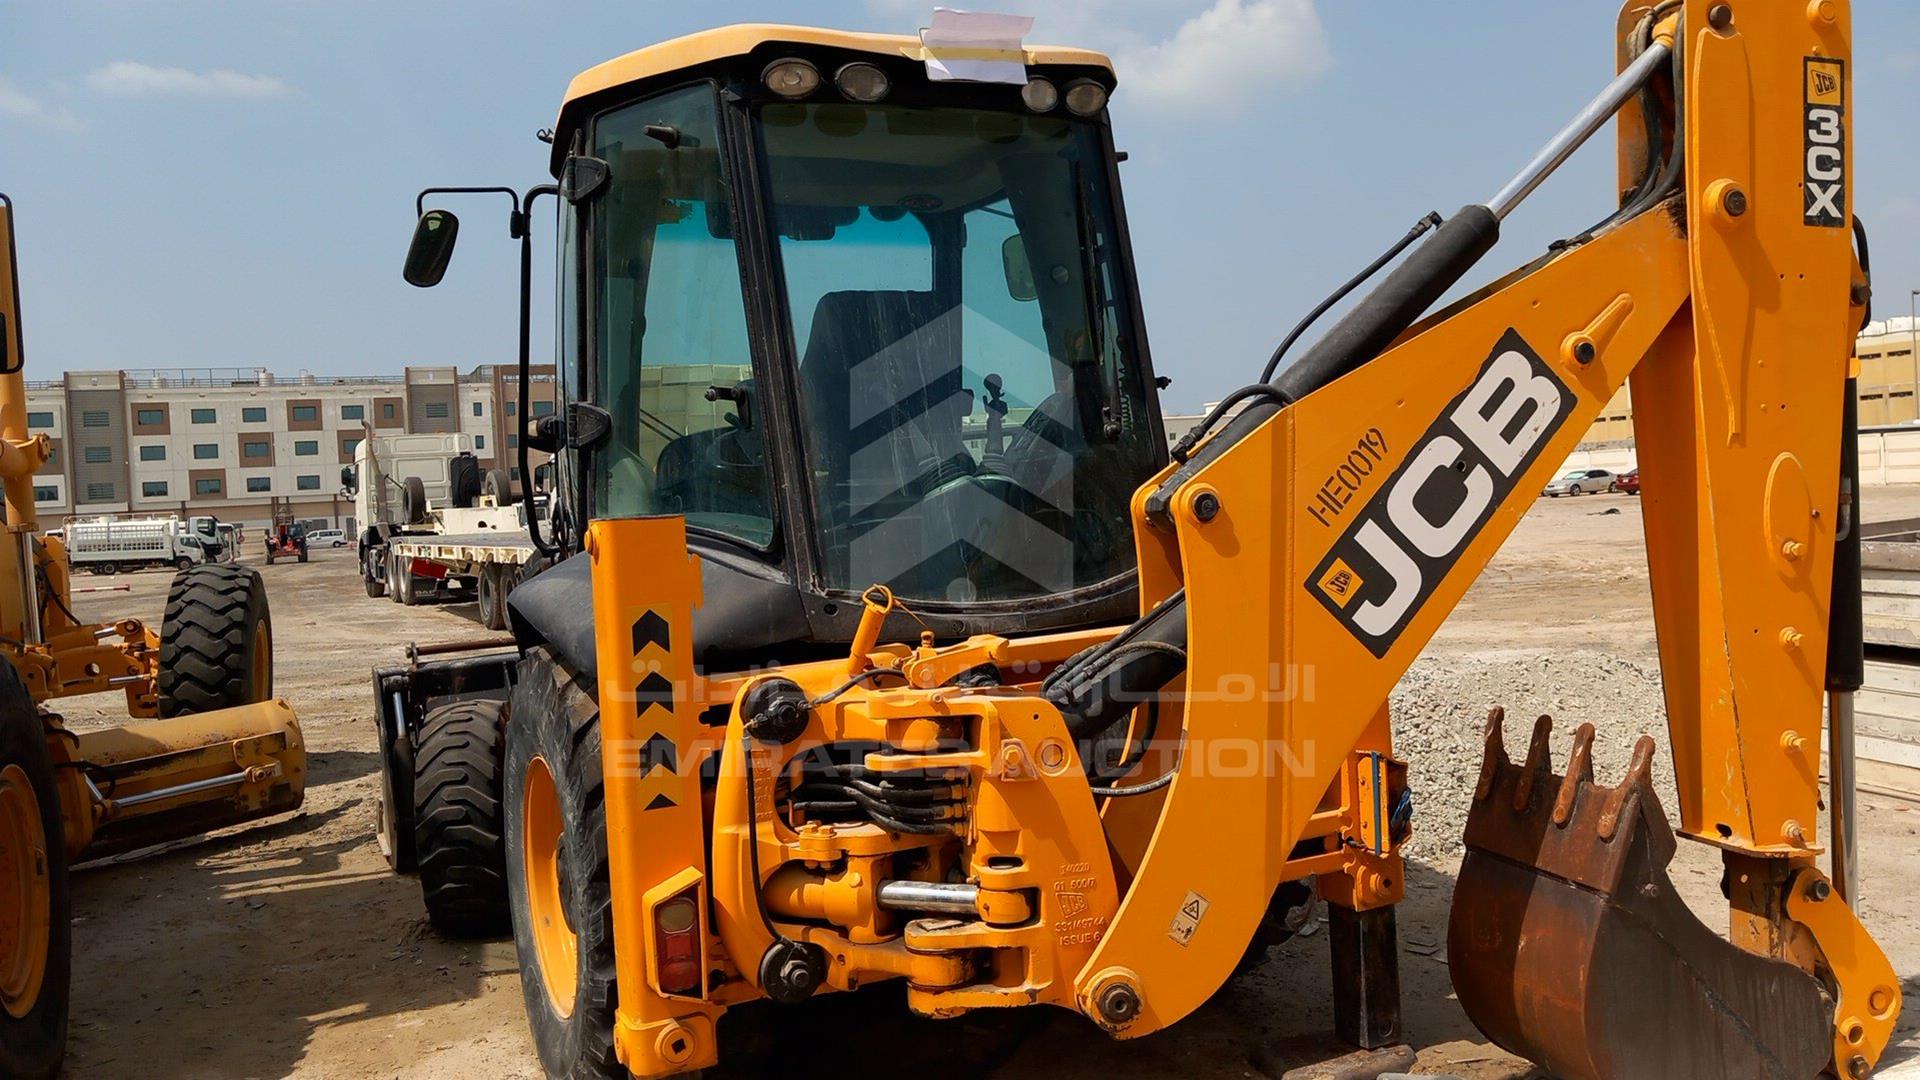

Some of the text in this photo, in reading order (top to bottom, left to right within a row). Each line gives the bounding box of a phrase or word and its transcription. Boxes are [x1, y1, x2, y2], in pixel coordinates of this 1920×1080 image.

[1814, 73, 1836, 94] JCB
[1806, 108, 1842, 218] 3CX
[1307, 428, 1391, 528] HE0019
[1352, 350, 1561, 637] JCB
[1329, 571, 1351, 593] JCB
[1060, 930, 1101, 946] ISSUE 6
